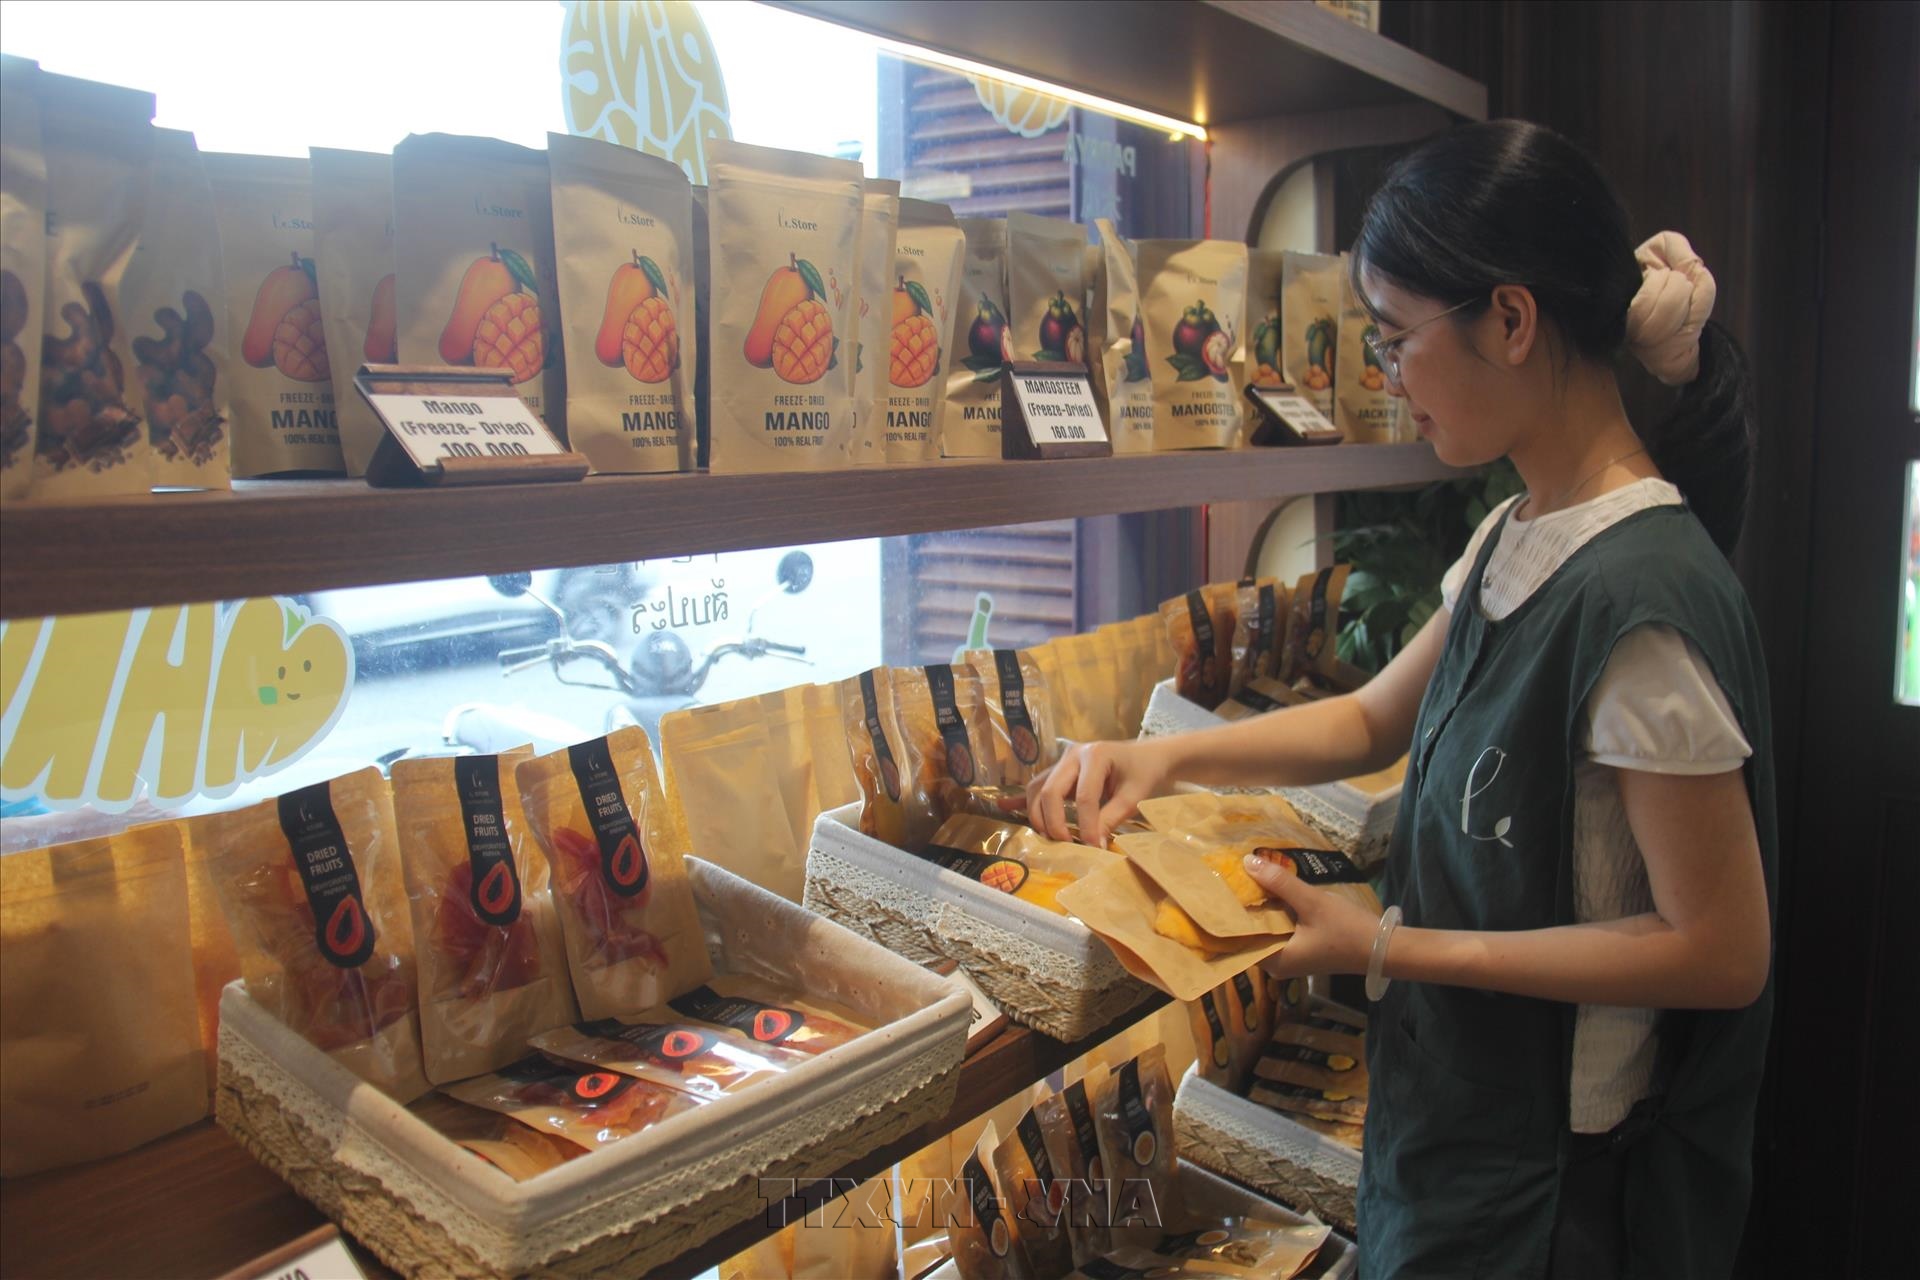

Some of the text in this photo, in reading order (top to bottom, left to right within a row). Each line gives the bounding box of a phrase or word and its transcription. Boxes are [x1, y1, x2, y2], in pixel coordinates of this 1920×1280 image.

[1024, 380, 1082, 395] MANGOSTEEN
[422, 400, 483, 415] Mango
[1027, 402, 1094, 418] (Freeze-Dried)
[400, 421, 535, 436] (Freeze- Dried)
[765, 411, 830, 431] MANGO
[774, 436, 795, 447] 100%
[795, 436, 811, 446] REAL
[595, 792, 617, 807] DRIED
[598, 802, 623, 817] FRUITS
[472, 814, 496, 825] DRIED
[473, 826, 499, 837] FRUITS
[306, 846, 337, 863] DRIED
[310, 857, 344, 877] FRUITS
